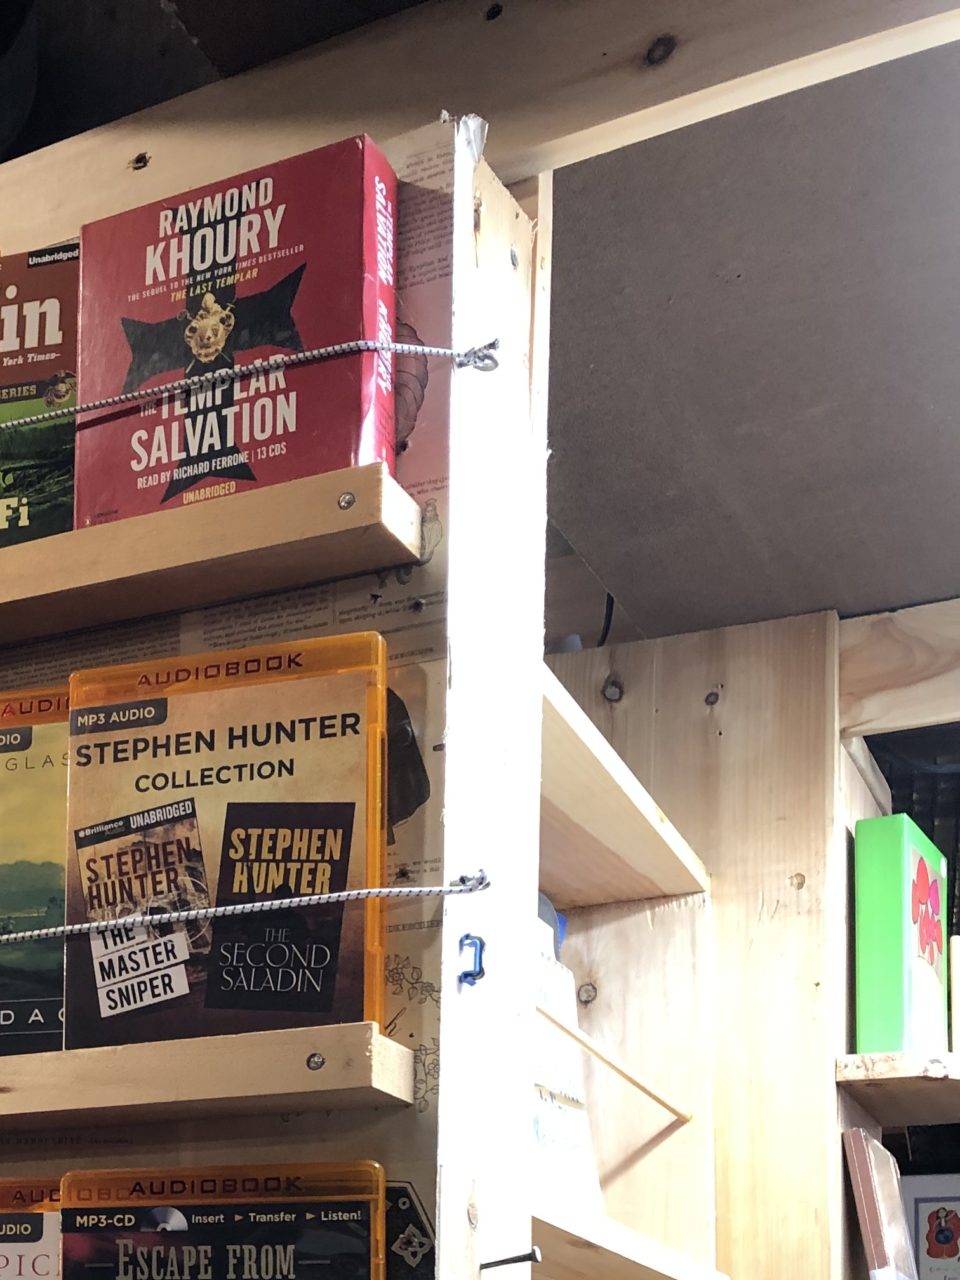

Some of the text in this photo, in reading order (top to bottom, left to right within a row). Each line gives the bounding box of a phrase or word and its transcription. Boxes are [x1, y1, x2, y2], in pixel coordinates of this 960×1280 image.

[158, 177, 274, 238] RAYMOND
[28, 249, 79, 266] Unabridged
[144, 204, 287, 285] KHOURY
[170, 268, 258, 302] THE LAST TEMPLAR
[158, 353, 288, 420] TEMPLAR
[130, 391, 297, 471] SALVATION
[137, 441, 287, 489] READ BY RICHARD FERRONE 13 CDS
[182, 480, 236, 504] UNABRIDGED
[137, 652, 305, 688] AUDIOBOOK
[76, 706, 156, 728] MP3 AUDIO
[74, 712, 361, 767] STEPHEN HUNTER
[135, 758, 295, 793] COLLECTION
[129, 800, 193, 829] UNABRIDGED
[85, 837, 191, 884] STEPHEN
[227, 827, 343, 862] STEPHEN
[87, 866, 180, 910] HUNTER
[231, 861, 332, 895] HUNTER
[97, 925, 136, 951] THE
[264, 927, 290, 943] THE
[98, 940, 178, 983] MASTER
[219, 943, 330, 969] SECOND
[105, 972, 175, 1012] SNIPER
[220, 967, 324, 993] SALADIN
[27, 1009, 45, 1025] A
[129, 1176, 304, 1197] AUDIOBOOK
[75, 1209, 362, 1228] MP3-CD Insert Transfer Listen!
[226, 1244, 296, 1280] FROM
